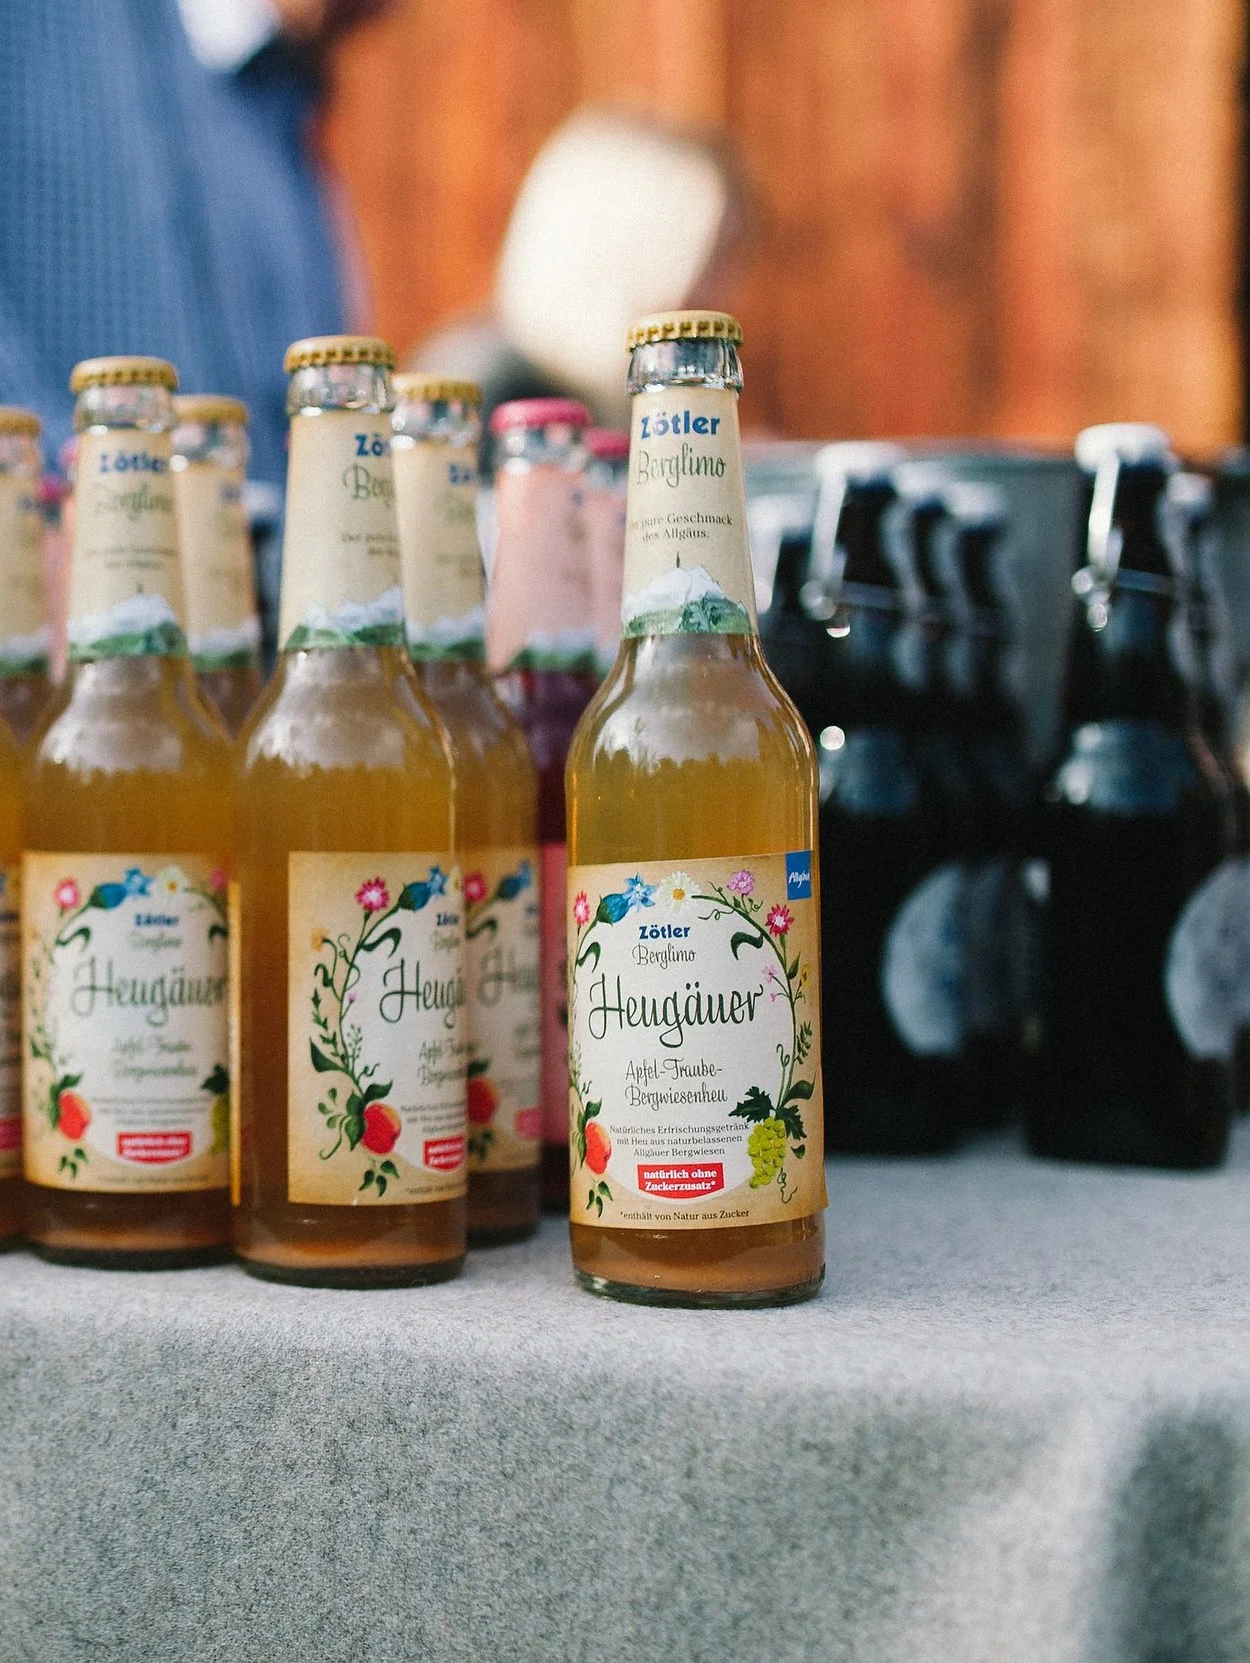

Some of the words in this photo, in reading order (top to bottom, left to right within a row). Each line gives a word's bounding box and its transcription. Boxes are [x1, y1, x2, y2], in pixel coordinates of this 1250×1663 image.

[641, 409, 721, 439] Zötler
[636, 442, 727, 488] Berglimo
[666, 511, 733, 526] Geschmack
[642, 530, 660, 541] des
[664, 527, 710, 541] Allgäus.
[639, 924, 692, 941] Zötler
[631, 942, 697, 970] Berglimo
[587, 972, 765, 1049] Heugäuer
[624, 1057, 724, 1087] Apfel-Traube-
[624, 1082, 728, 1112] Bergwiesenheu
[609, 1124, 656, 1135] Natürliches
[657, 1122, 750, 1135] Erfrischungsgetränk
[616, 1136, 630, 1146] mit
[631, 1136, 648, 1146] Heu
[650, 1136, 666, 1146] aus
[667, 1135, 743, 1146] naturbelassenen
[633, 1148, 670, 1159] Allgäuer
[671, 1147, 726, 1158] Bergwiesen
[643, 1167, 689, 1180] natürlich
[690, 1168, 717, 1179] ohne
[655, 1212, 672, 1221] von
[672, 1210, 700, 1221] Natur
[701, 1211, 718, 1220] aus
[719, 1208, 750, 1220] Zucker
